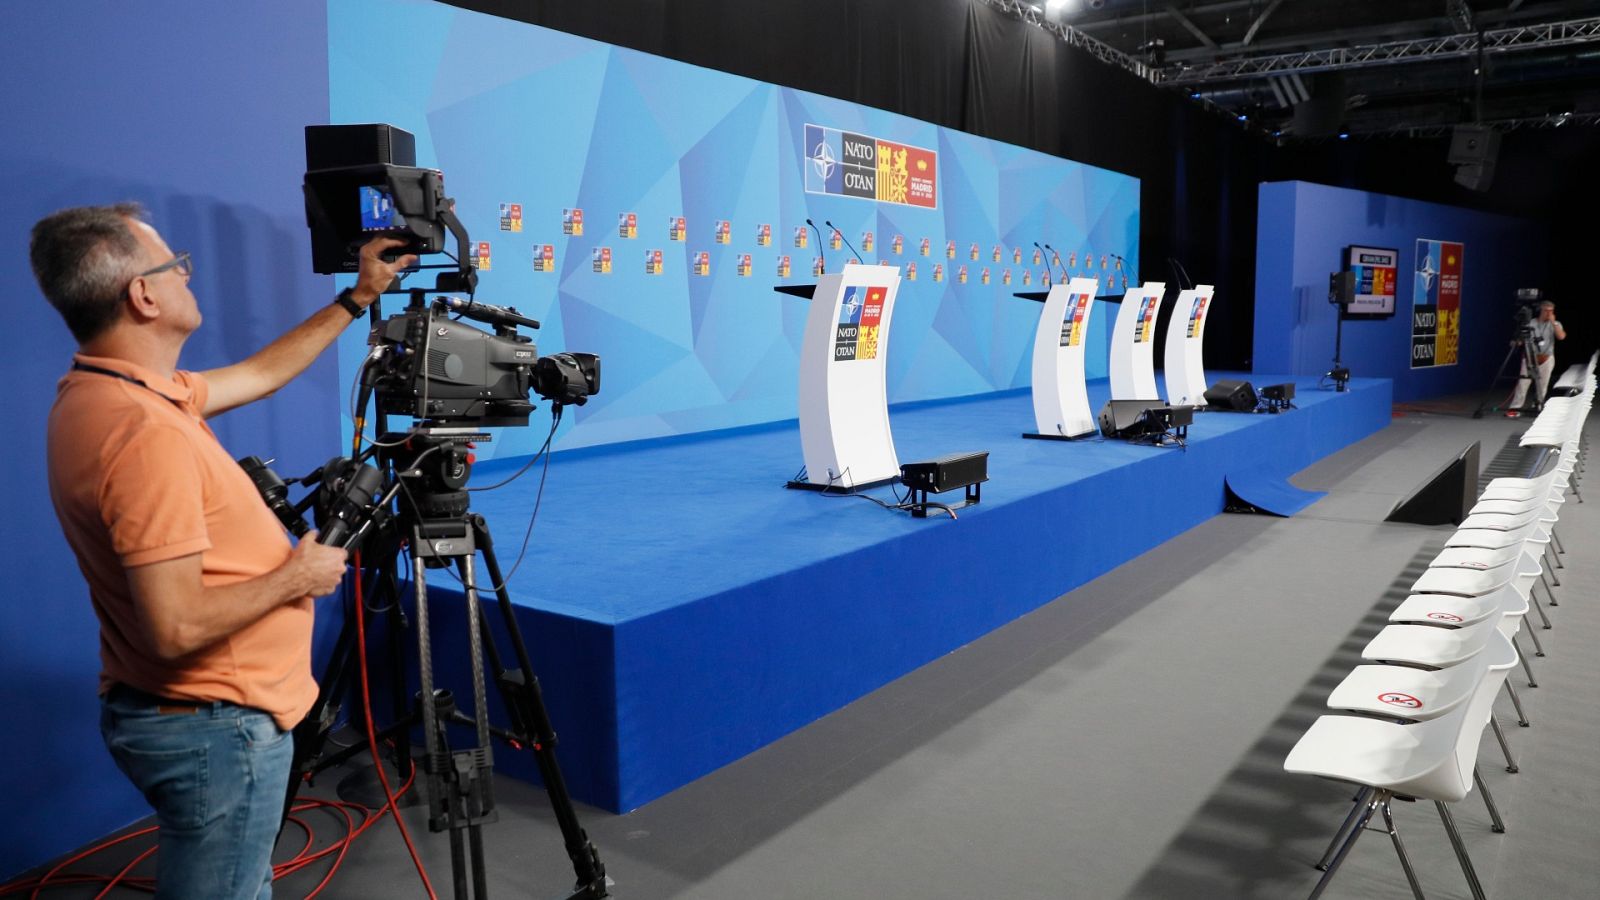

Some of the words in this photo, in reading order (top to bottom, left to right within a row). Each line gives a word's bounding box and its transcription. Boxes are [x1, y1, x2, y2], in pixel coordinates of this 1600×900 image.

[844, 140, 874, 160] NATO
[844, 172, 874, 191] OTAN
[911, 182, 932, 193] MADRID
[1415, 312, 1436, 328] NATO
[837, 327, 857, 338] NATO
[836, 346, 855, 356] OTAN
[1413, 343, 1434, 359] OTAN
